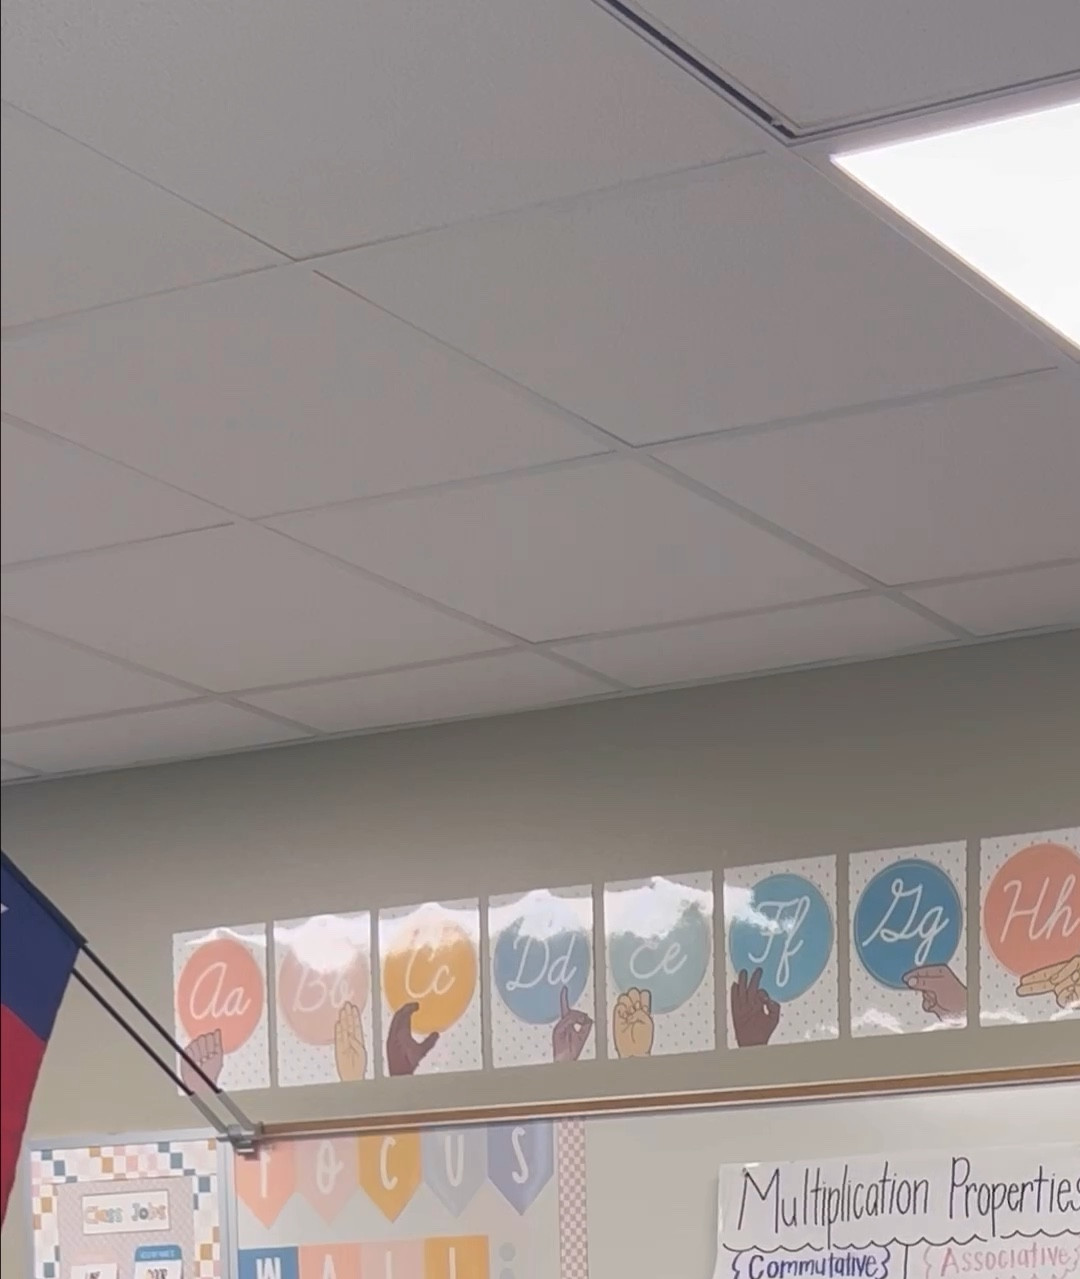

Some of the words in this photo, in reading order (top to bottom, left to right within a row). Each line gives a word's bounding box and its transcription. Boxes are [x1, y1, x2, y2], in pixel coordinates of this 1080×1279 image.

[748, 896, 811, 988] Ff
[862, 878, 950, 967] Gg
[1000, 874, 1080, 944] Hh
[190, 960, 251, 1020] Aa
[404, 930, 456, 999] Cc
[506, 933, 578, 990] Dd
[737, 1161, 929, 1250] Multiplication
[940, 1241, 1073, 1278] Associative
